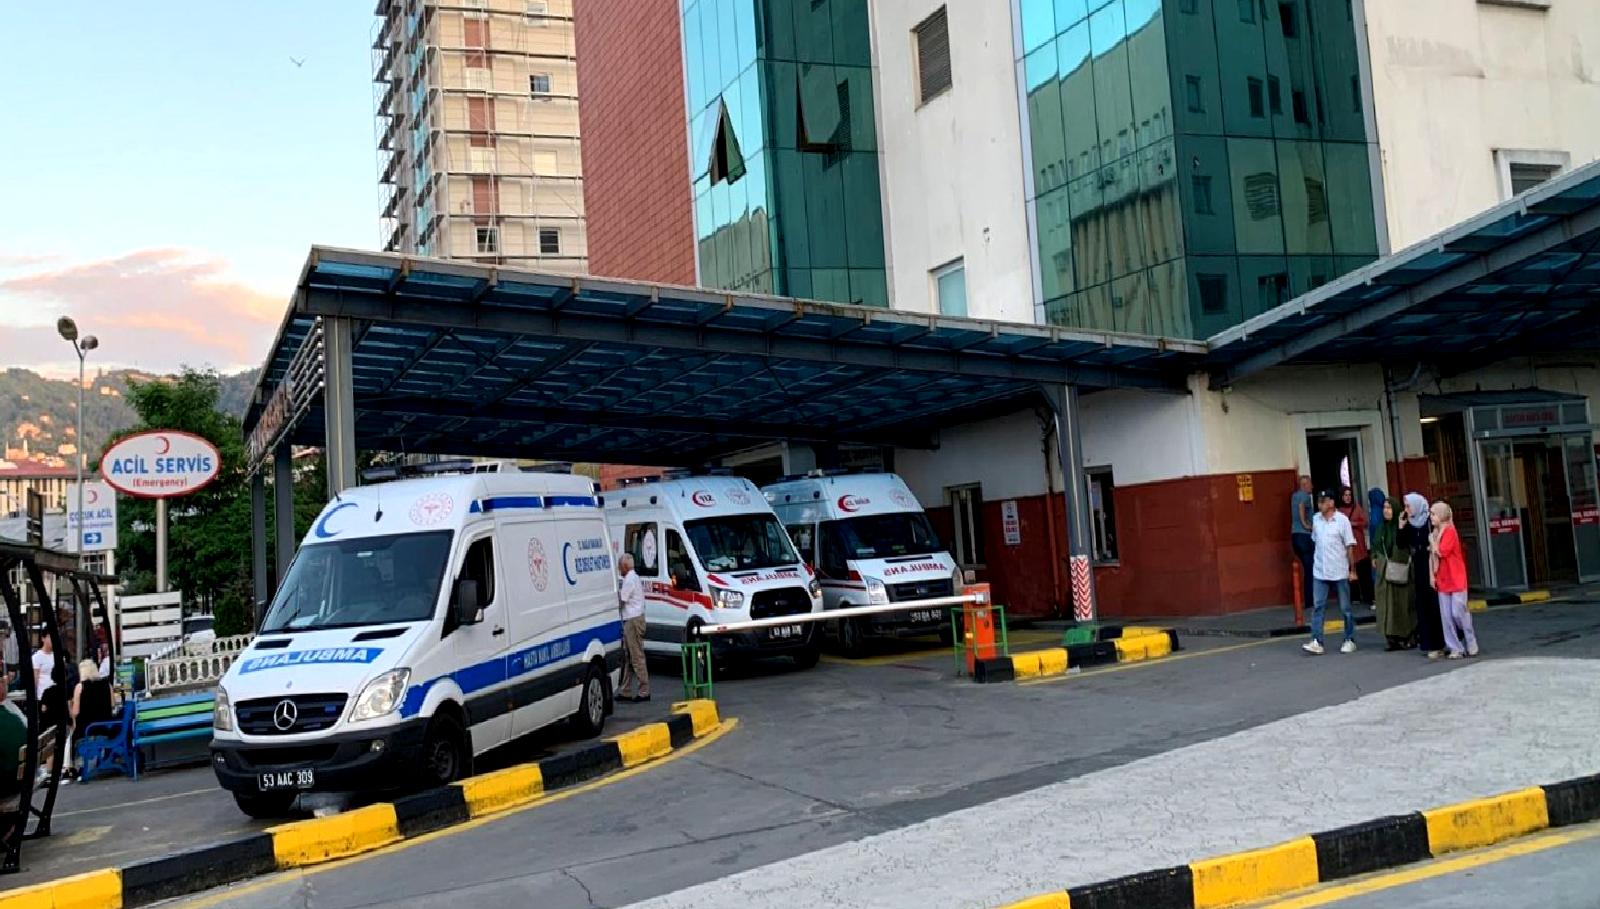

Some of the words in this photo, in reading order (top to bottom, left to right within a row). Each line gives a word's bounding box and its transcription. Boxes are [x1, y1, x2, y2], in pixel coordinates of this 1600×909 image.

[112, 454, 149, 474] ACİL
[156, 453, 212, 473] SERVİS
[133, 478, 187, 487] (Emergency)
[263, 774, 274, 787] 53
[277, 773, 293, 786] AAC
[296, 769, 313, 785] 309
